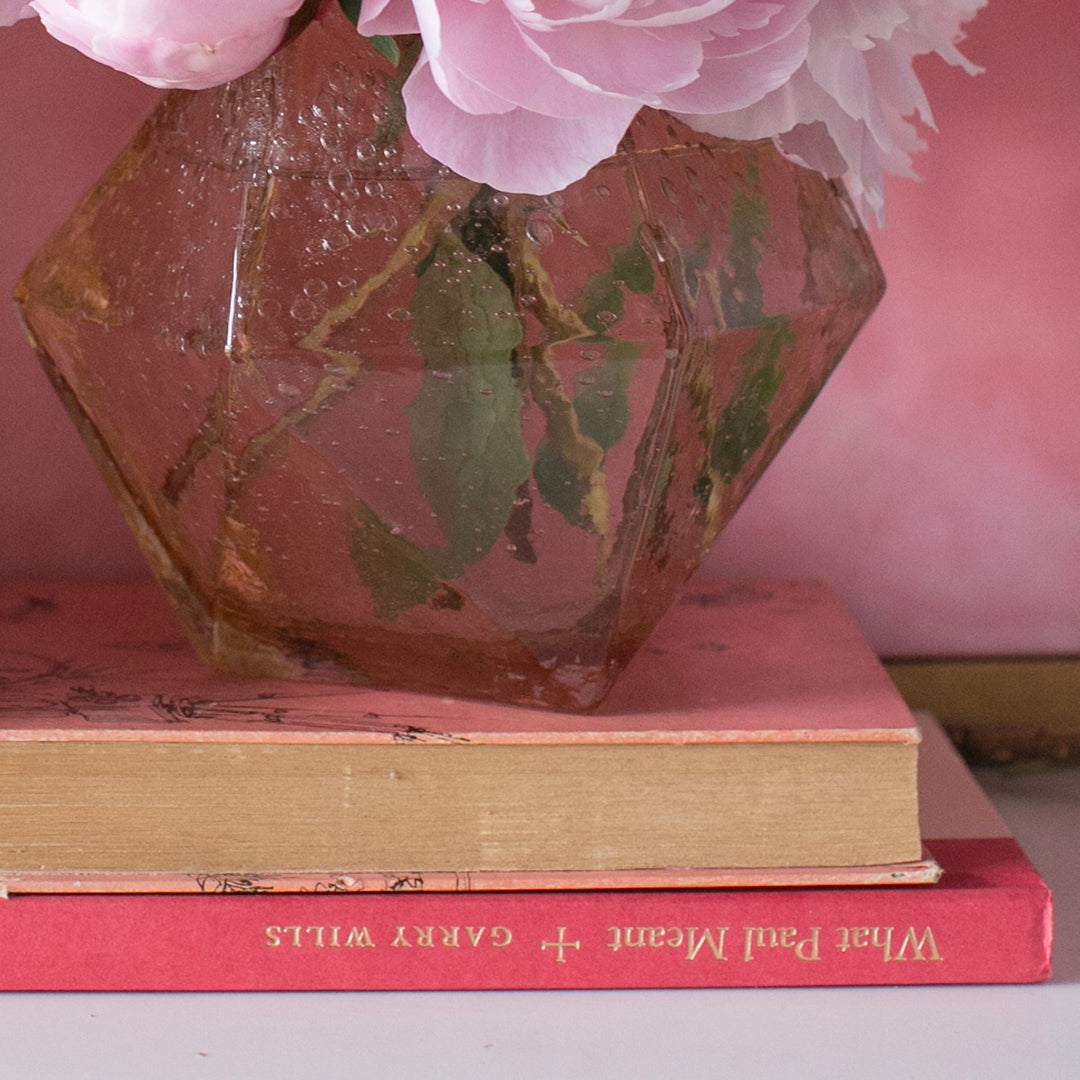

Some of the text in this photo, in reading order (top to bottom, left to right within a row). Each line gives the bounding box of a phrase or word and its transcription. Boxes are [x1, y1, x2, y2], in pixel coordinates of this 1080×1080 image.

[265, 925, 514, 948] GARRY WILLS
[607, 925, 945, 963] What Paul Meant
